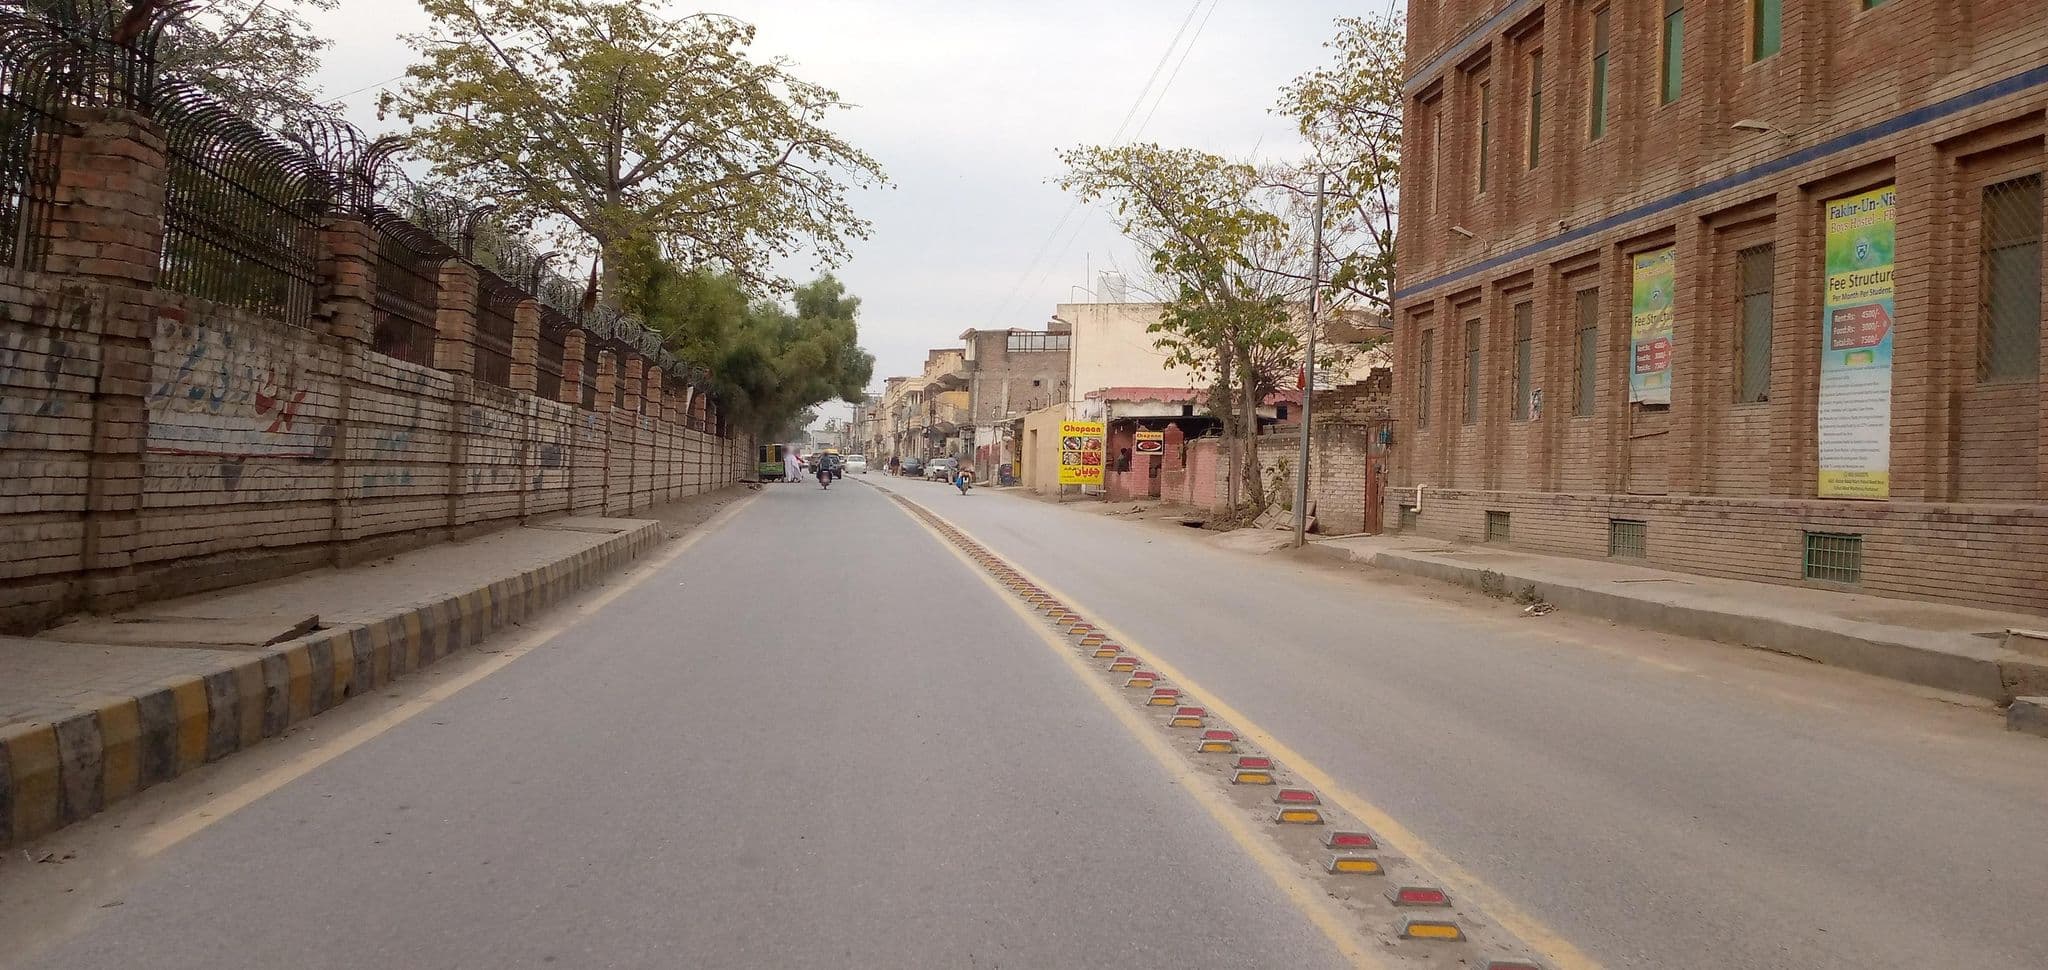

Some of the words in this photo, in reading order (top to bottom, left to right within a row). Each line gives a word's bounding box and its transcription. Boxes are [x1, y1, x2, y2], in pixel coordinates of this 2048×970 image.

[1850, 213, 1875, 229] Hostel
[1829, 277, 1846, 291] Fee
[1832, 294, 1841, 302] Per
[1841, 292, 1858, 301] Month
[1860, 290, 1869, 298] Per
[1634, 315, 1645, 327] Fee
[1063, 425, 1100, 434] Chopaan
